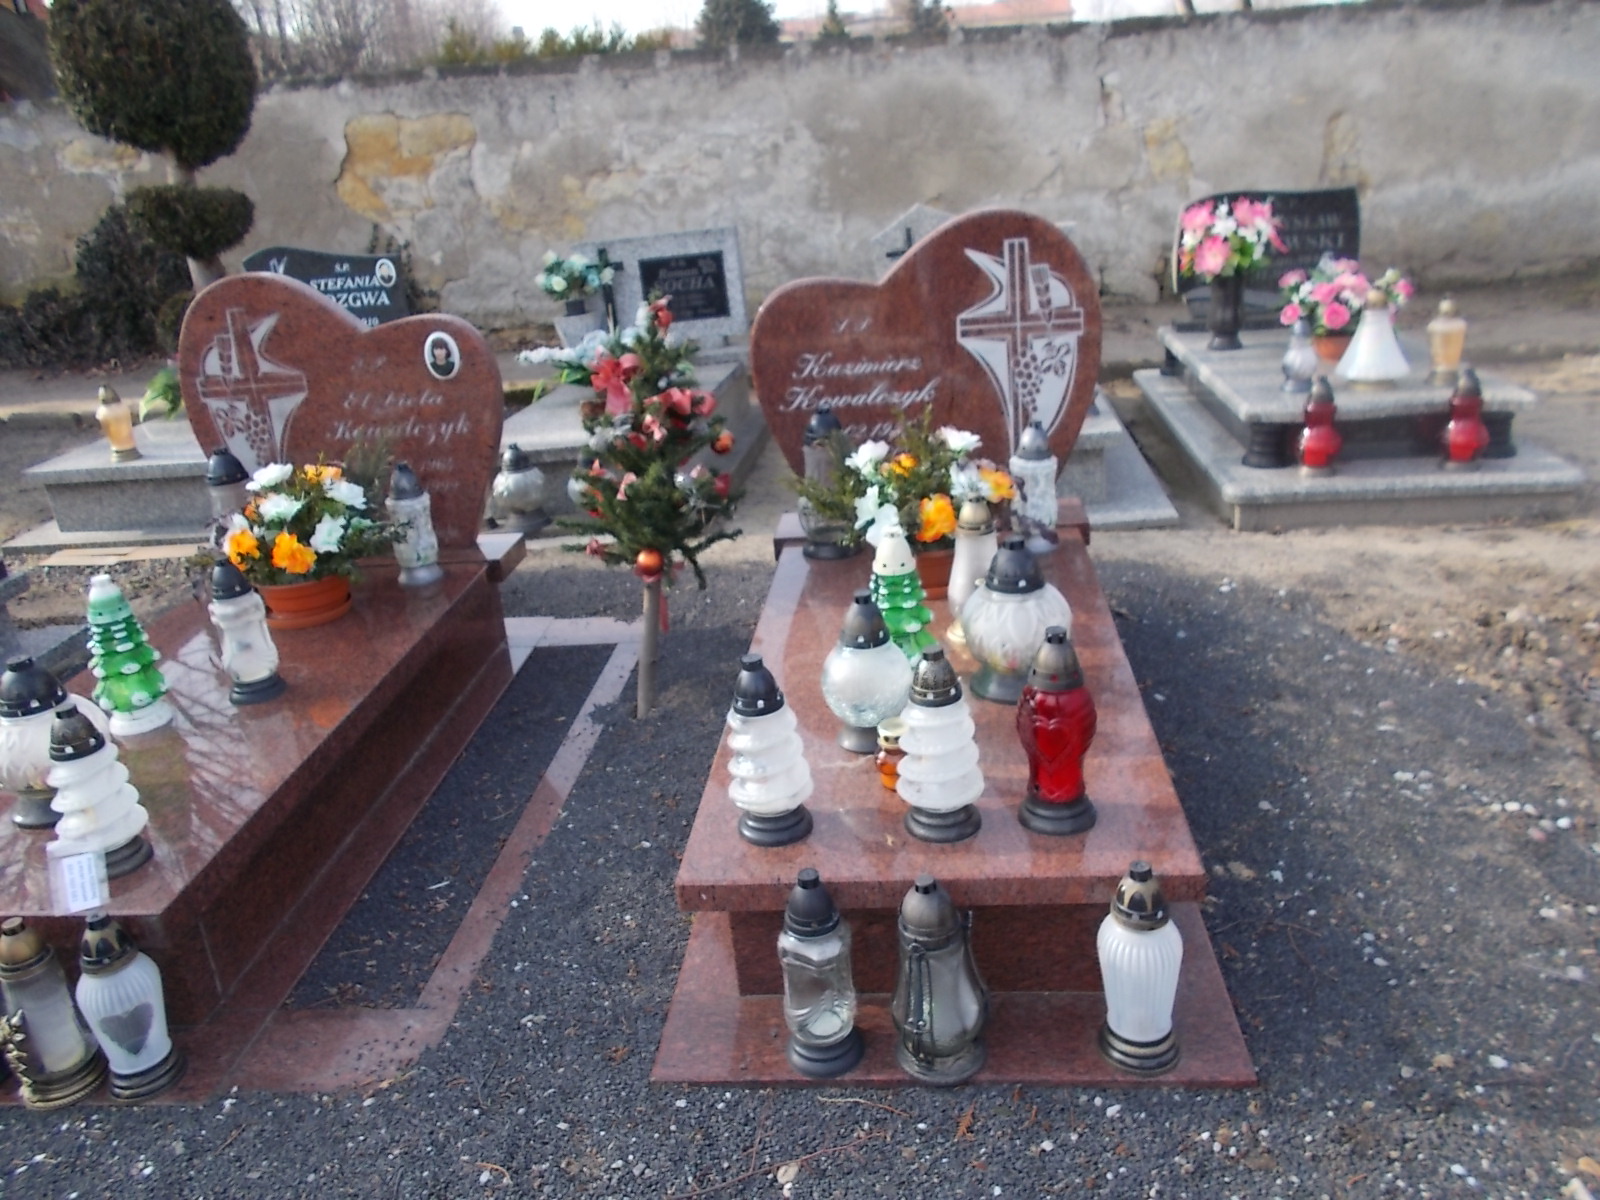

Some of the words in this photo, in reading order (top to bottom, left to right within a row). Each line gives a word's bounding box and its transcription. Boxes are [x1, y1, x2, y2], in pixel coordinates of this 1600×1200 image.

[310, 275, 380, 292] STEFANIA
[791, 351, 922, 379] Kazimierz
[779, 376, 942, 412] Kowalczyk
